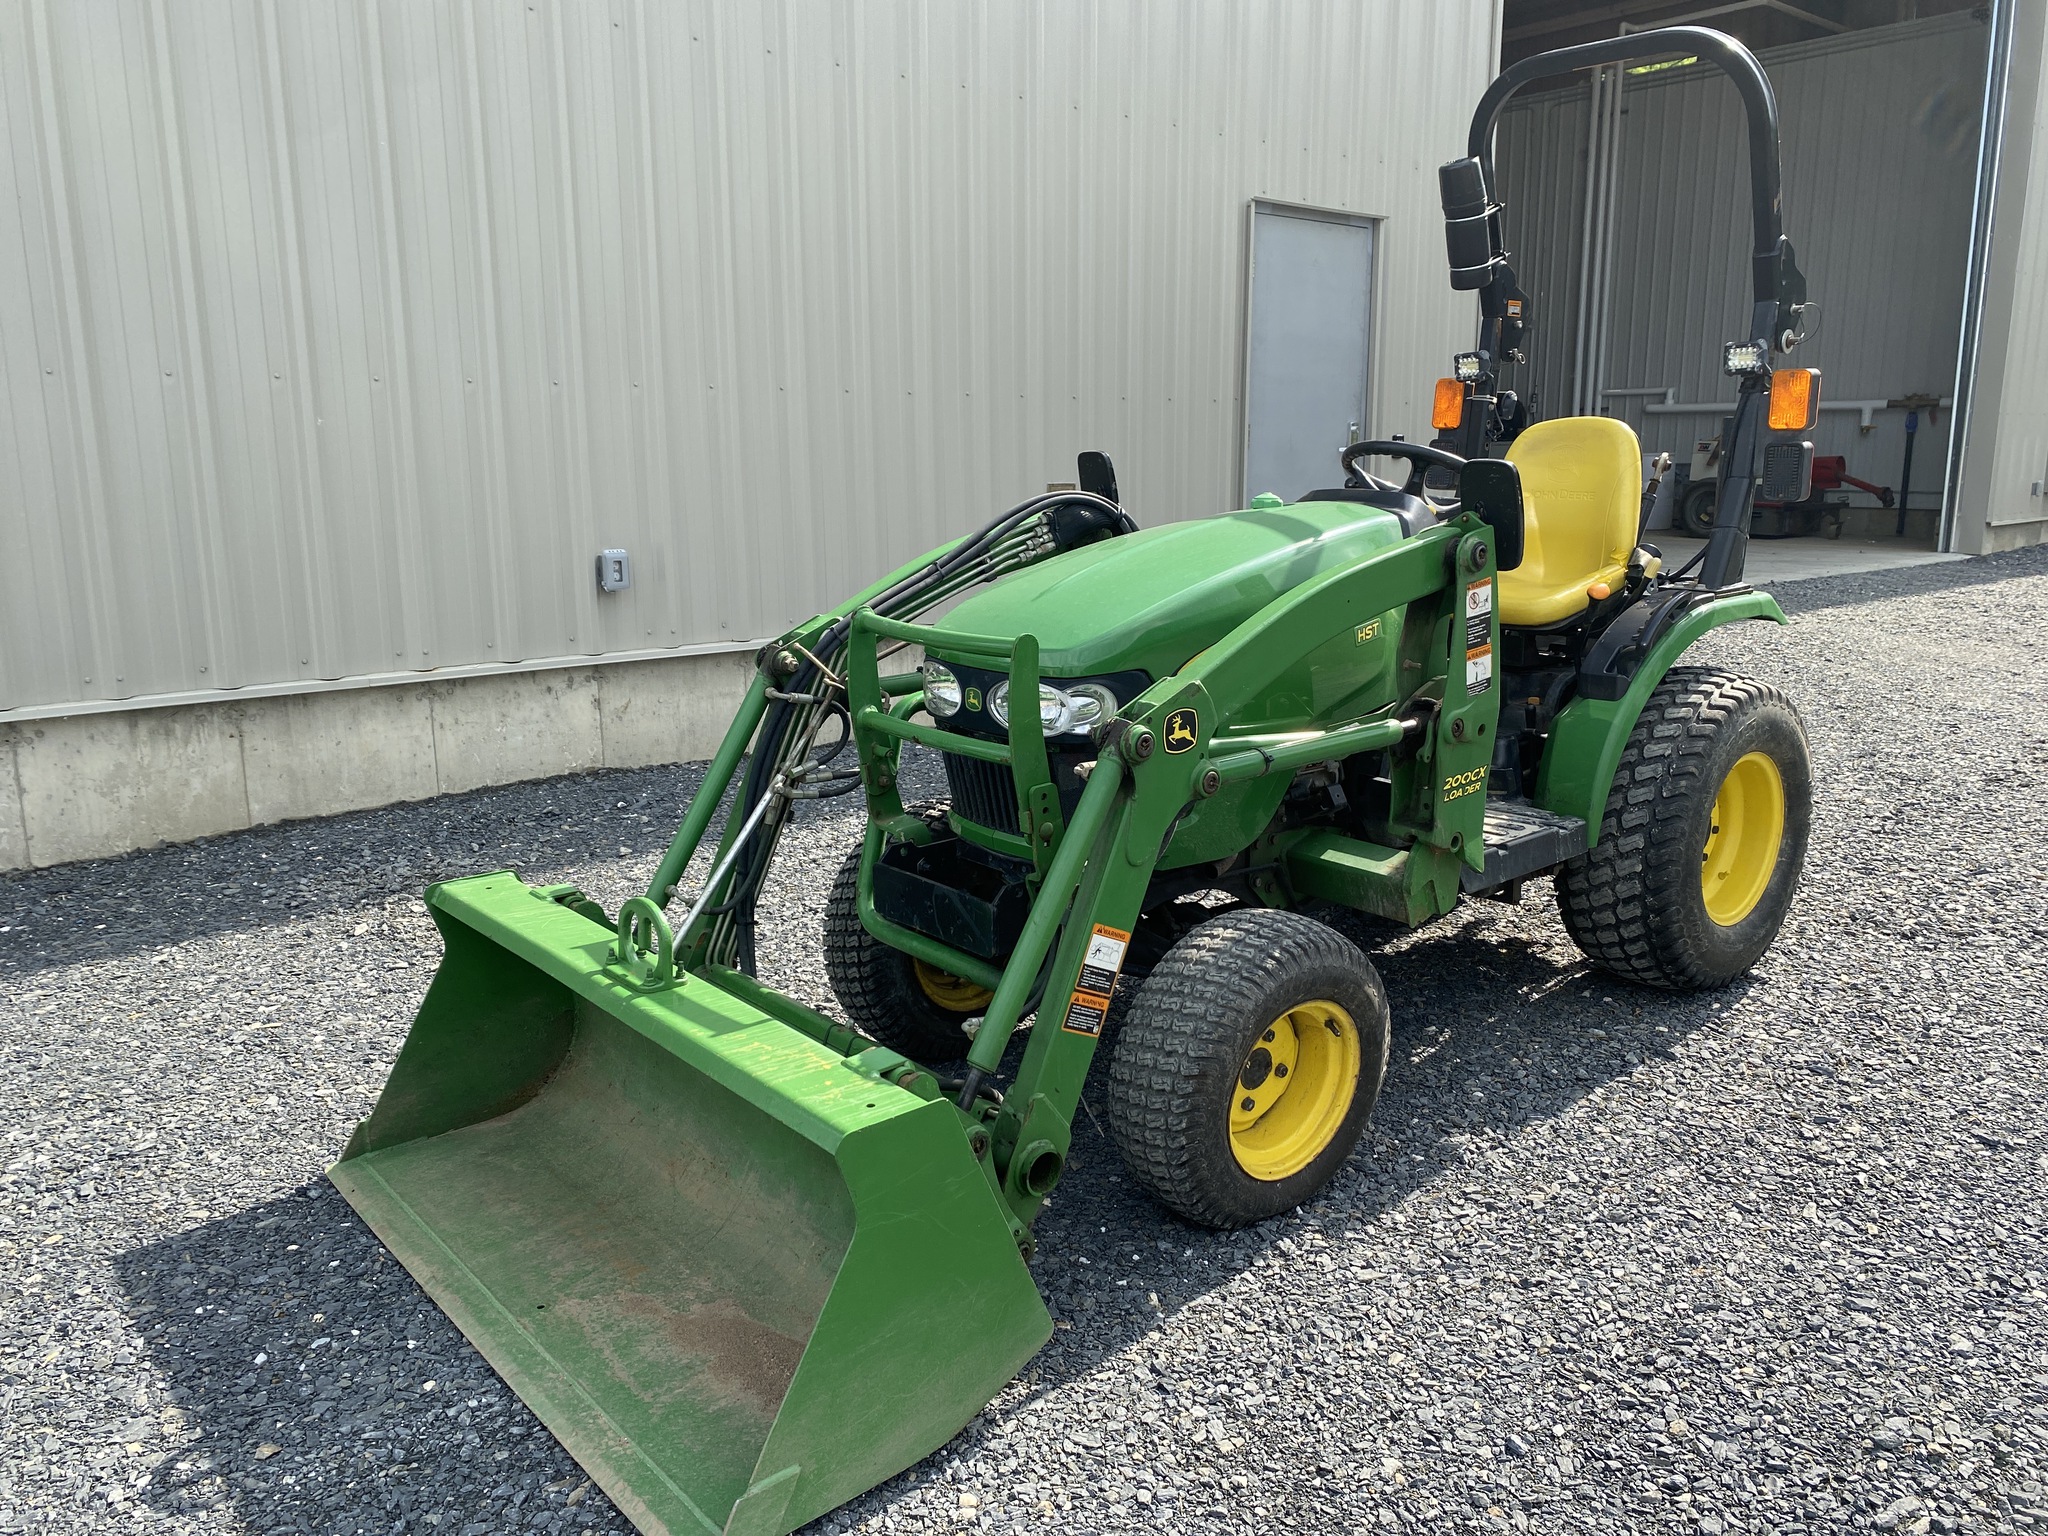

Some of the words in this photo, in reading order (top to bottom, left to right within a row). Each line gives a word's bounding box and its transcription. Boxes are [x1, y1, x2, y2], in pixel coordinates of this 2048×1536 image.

[1525, 488, 1559, 501] JOHN
[1559, 488, 1597, 501] DEERE
[1357, 622, 1379, 643] HST
[1443, 764, 1488, 790] 200CX
[1443, 781, 1481, 802] LOADER
[1103, 927, 1126, 940] WARNING
[1081, 998, 1105, 1009] WARNING
